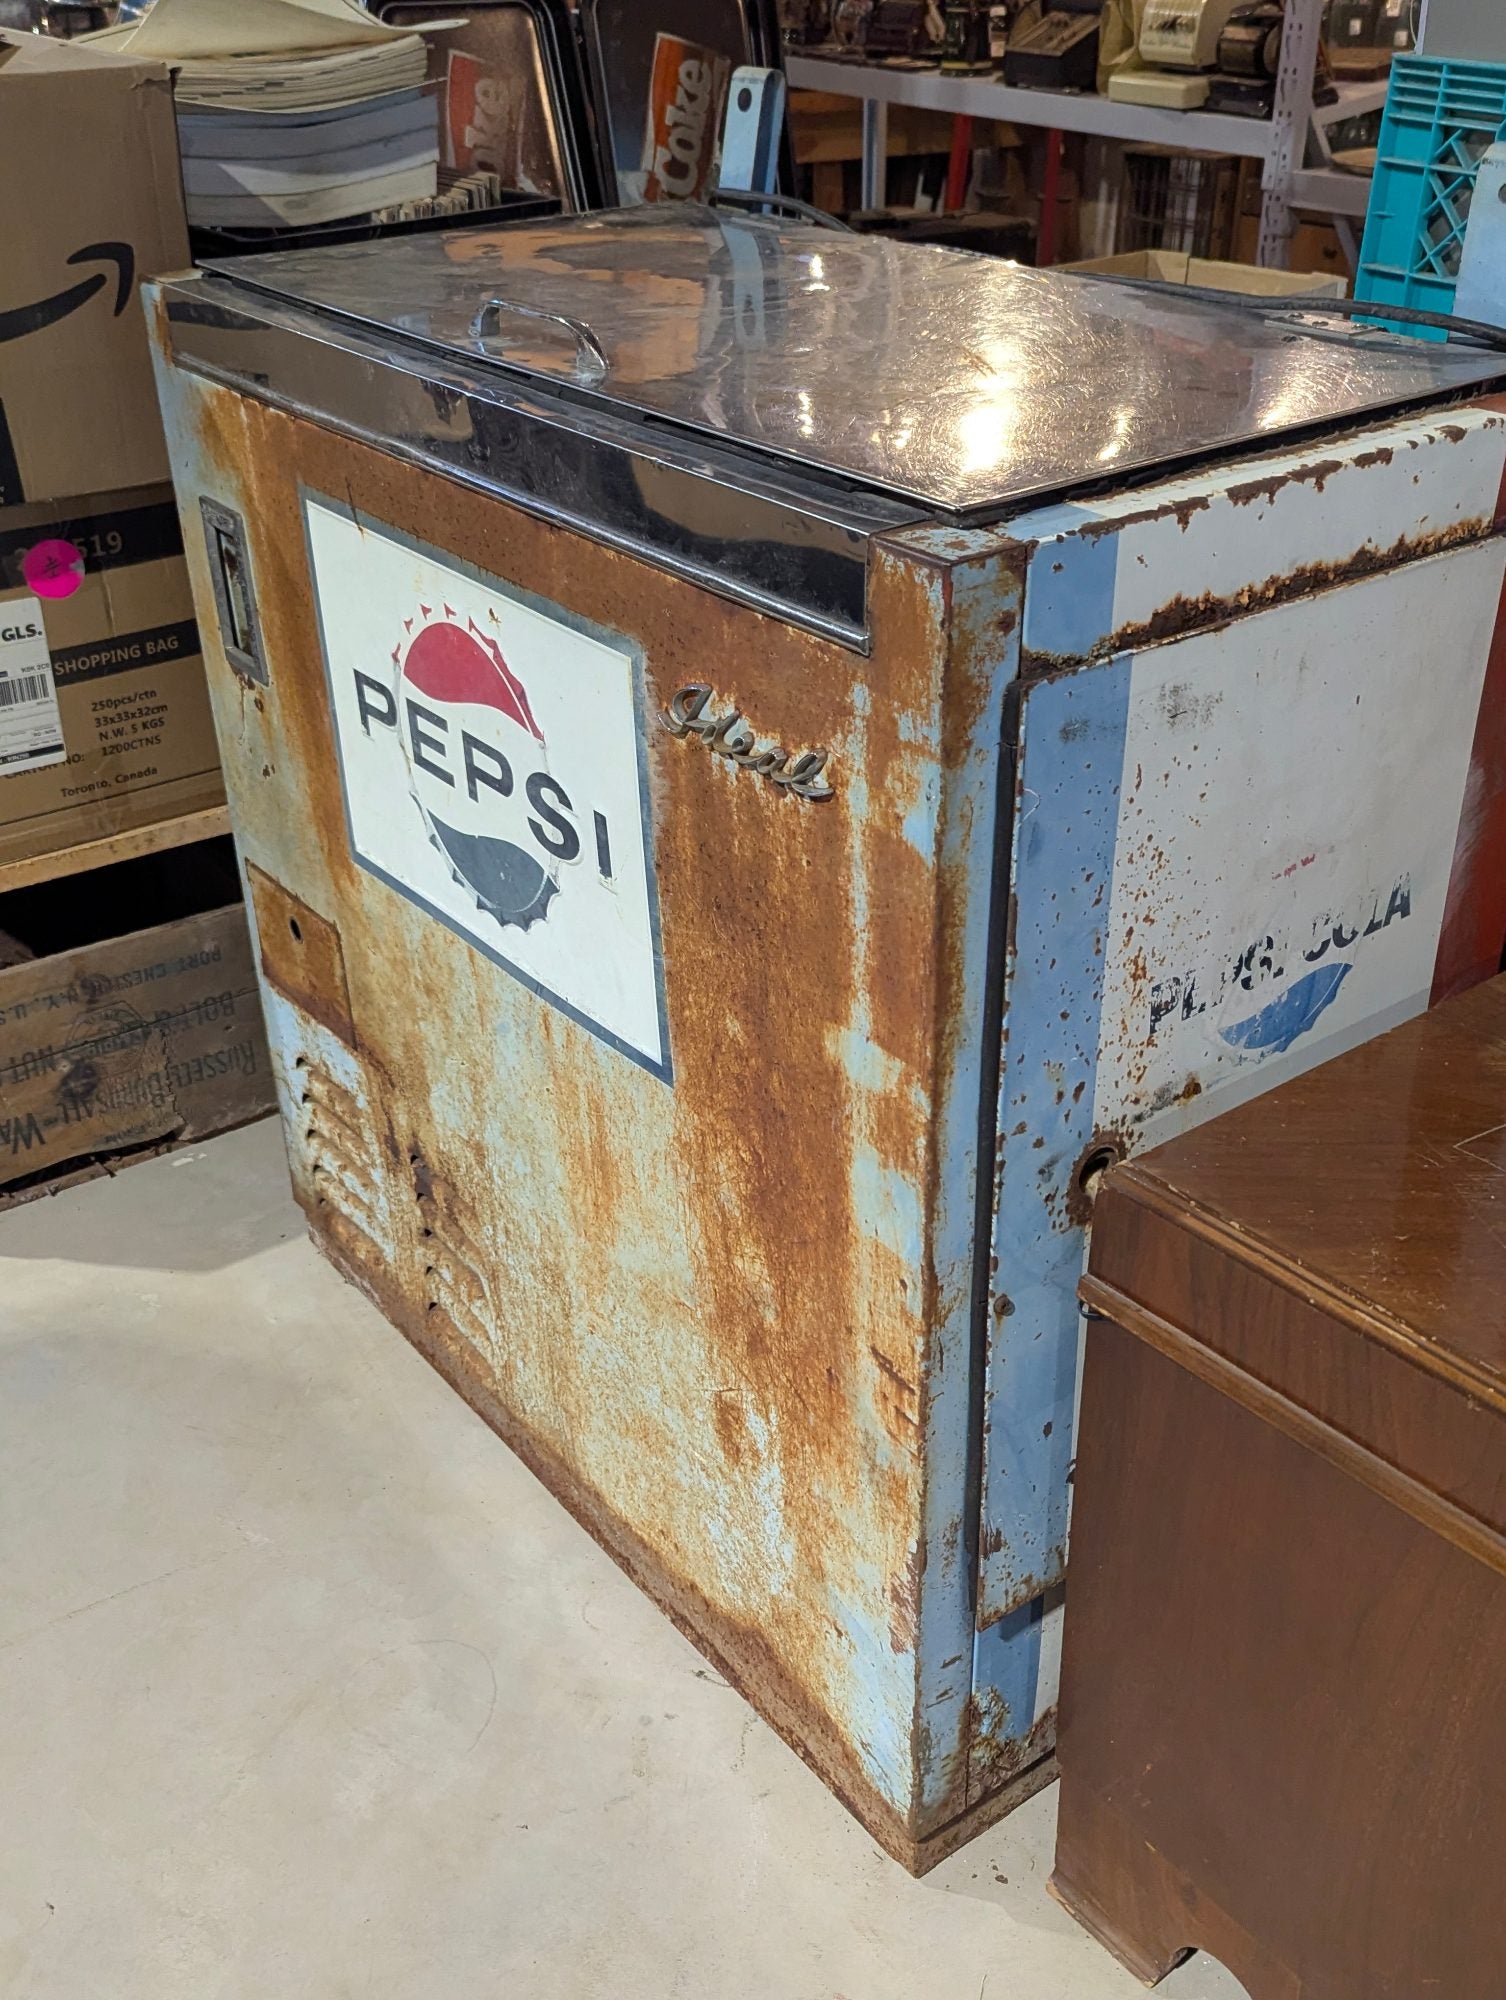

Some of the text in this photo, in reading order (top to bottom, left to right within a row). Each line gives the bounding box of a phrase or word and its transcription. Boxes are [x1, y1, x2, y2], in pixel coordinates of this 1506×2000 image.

[464, 79, 508, 173] oke
[653, 59, 712, 196] Coke
[54, 635, 179, 675] SHOPPING BAG
[131, 724, 138, 733] 5
[142, 717, 165, 731] KGS
[115, 766, 158, 784] Canada
[353, 668, 613, 879] PEPSI
